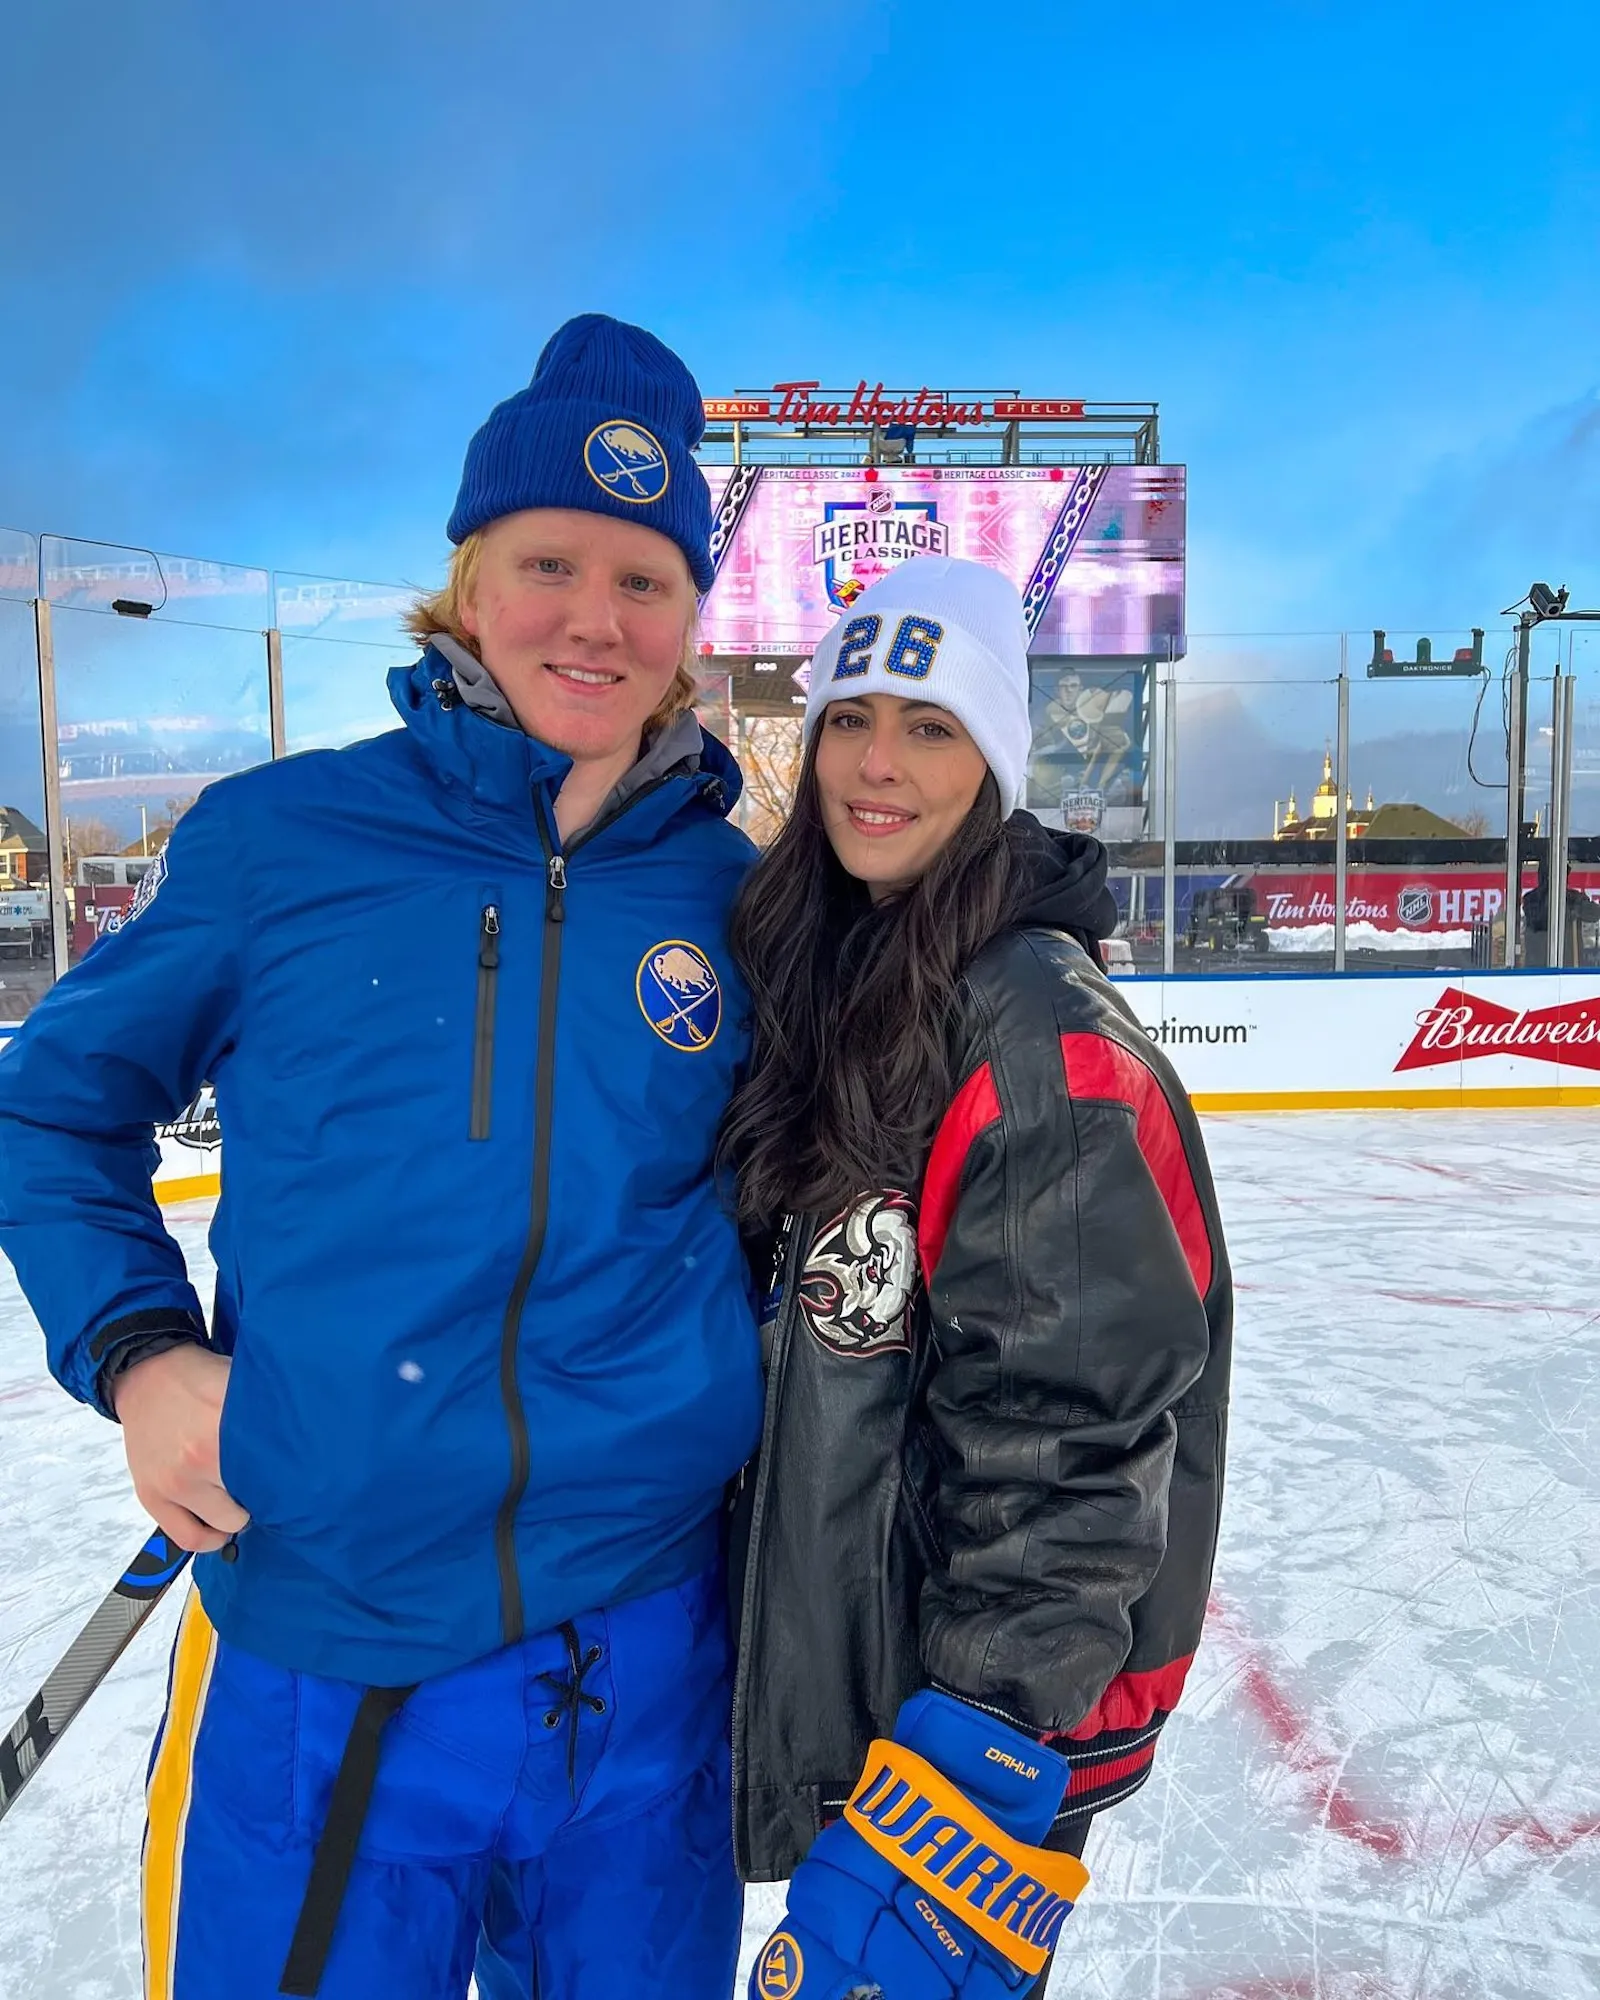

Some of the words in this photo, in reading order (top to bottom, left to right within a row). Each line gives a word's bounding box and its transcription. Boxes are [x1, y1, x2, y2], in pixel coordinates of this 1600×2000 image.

[773, 381, 838, 426] Tim
[846, 380, 984, 426] Hortons
[1007, 403, 1072, 414] FIELD
[944, 470, 985, 479] HERITAGE
[988, 470, 1025, 479] CLASSIC
[820, 520, 942, 555] HERITAGE
[831, 614, 945, 681] 26
[1266, 893, 1304, 919] Tim
[1414, 1006, 1600, 1050] Budweis
[984, 1746, 1040, 1780] DAHLIN
[851, 1763, 1075, 1955] WARRIO
[915, 1899, 963, 1957] COVERT
